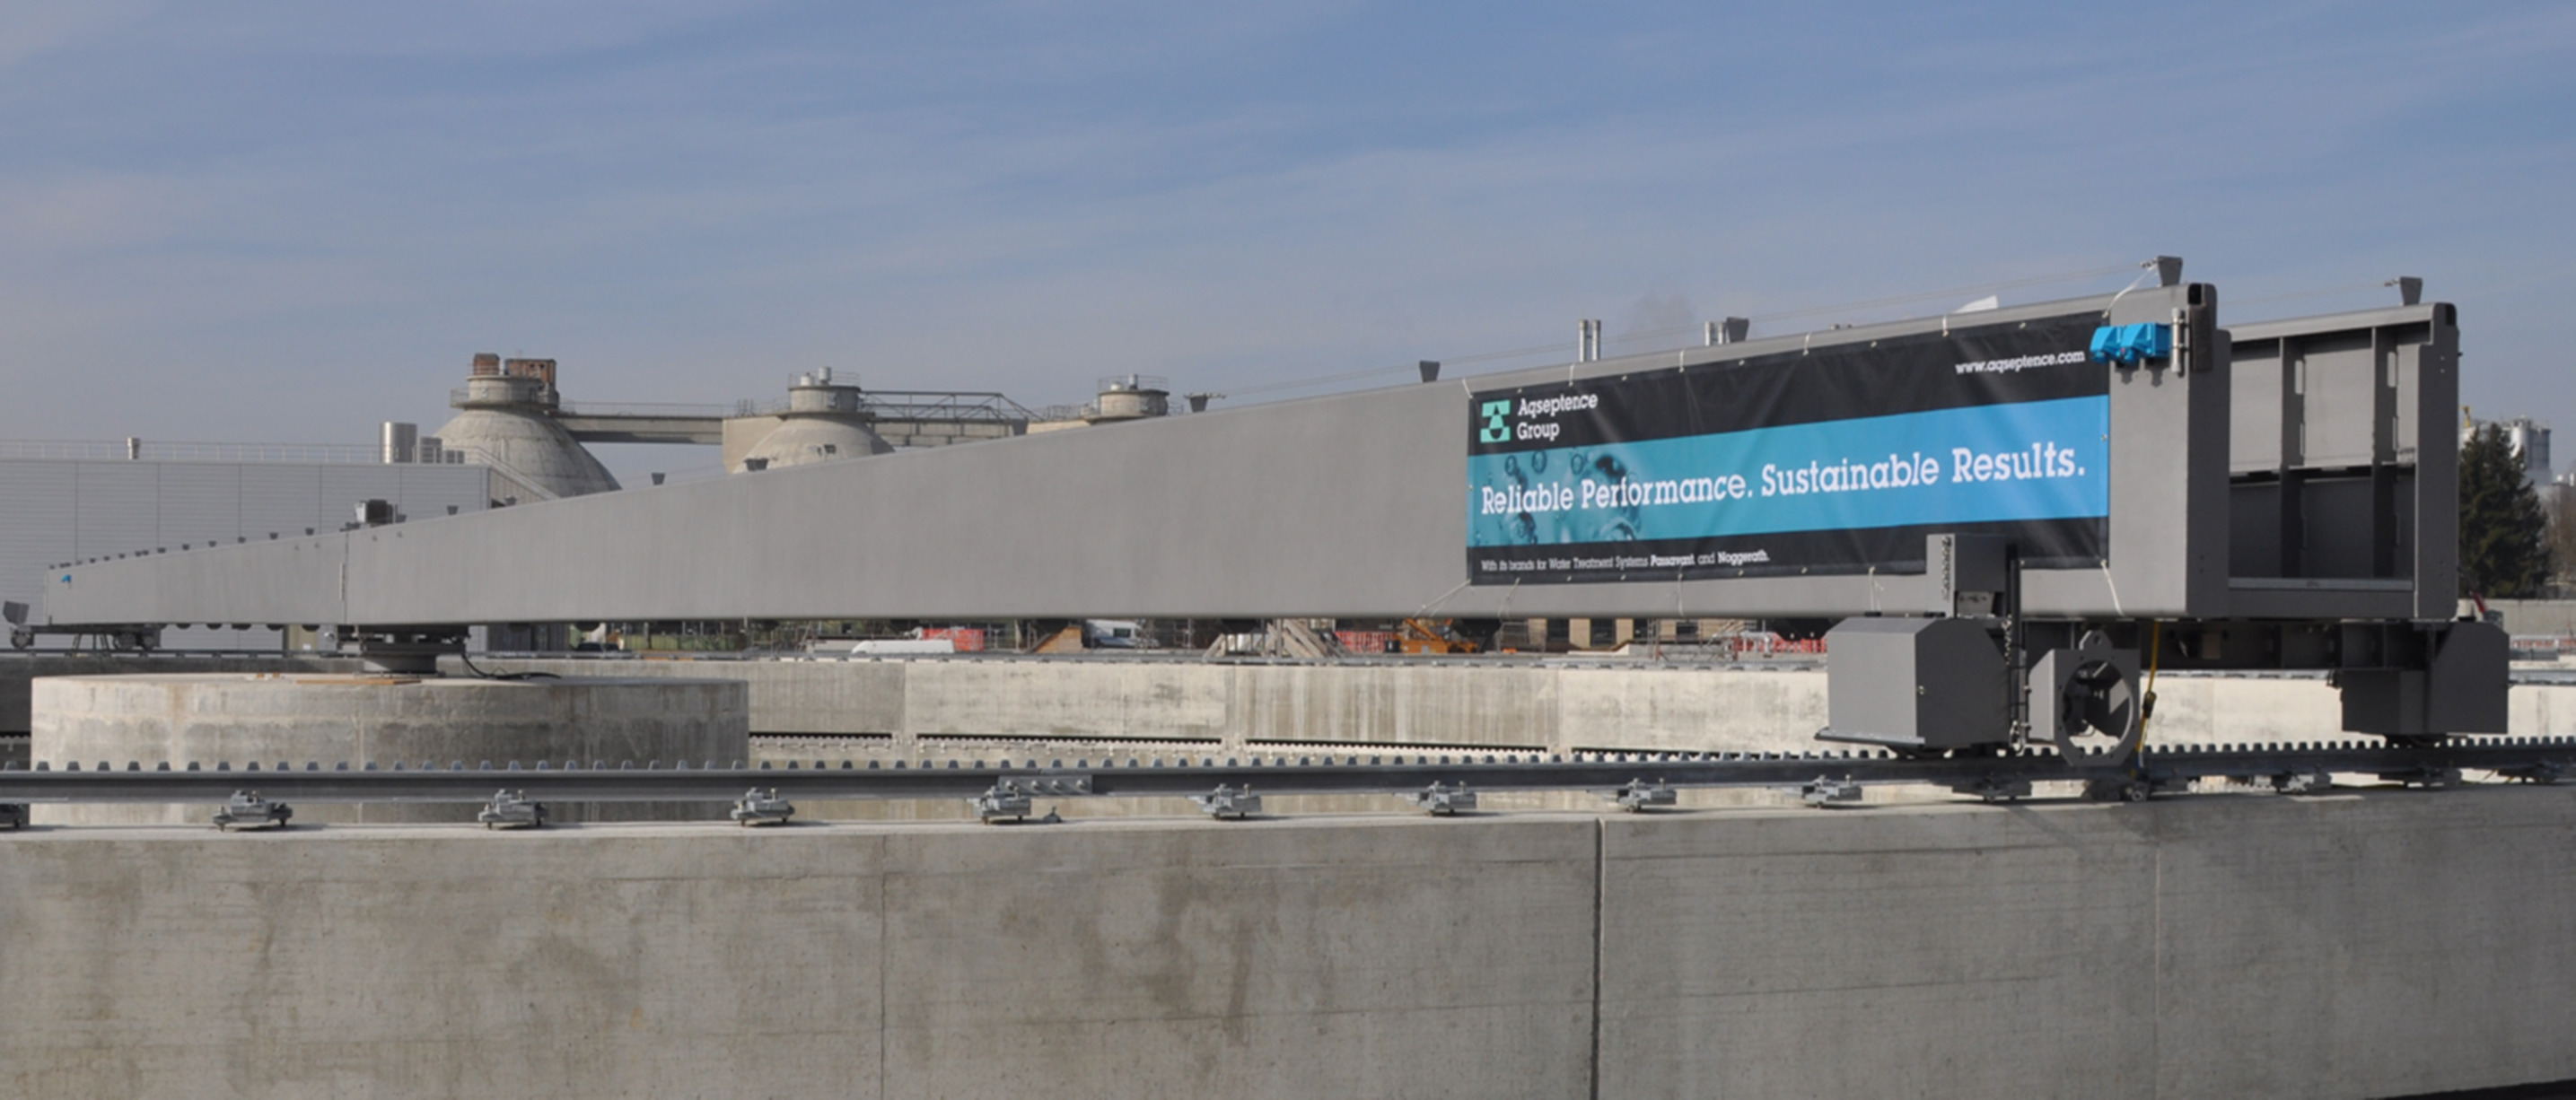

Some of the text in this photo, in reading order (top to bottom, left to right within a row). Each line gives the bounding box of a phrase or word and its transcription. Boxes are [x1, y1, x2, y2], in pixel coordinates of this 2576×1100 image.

[1955, 351, 2085, 374] www.aqseptence.com
[1518, 394, 1598, 419] Aqseptence
[1517, 422, 1560, 441] Group
[1481, 441, 2085, 514] Reliable Performance. Sustainable Results.
[1481, 560, 1497, 572] With
[1509, 560, 1535, 571] brands
[1537, 559, 1546, 570] for
[1548, 557, 1571, 570] Water
[1573, 556, 1613, 569] Treatment
[1616, 555, 1648, 570] Systems
[1650, 554, 1695, 567] Passavant
[1697, 552, 1715, 565] and
